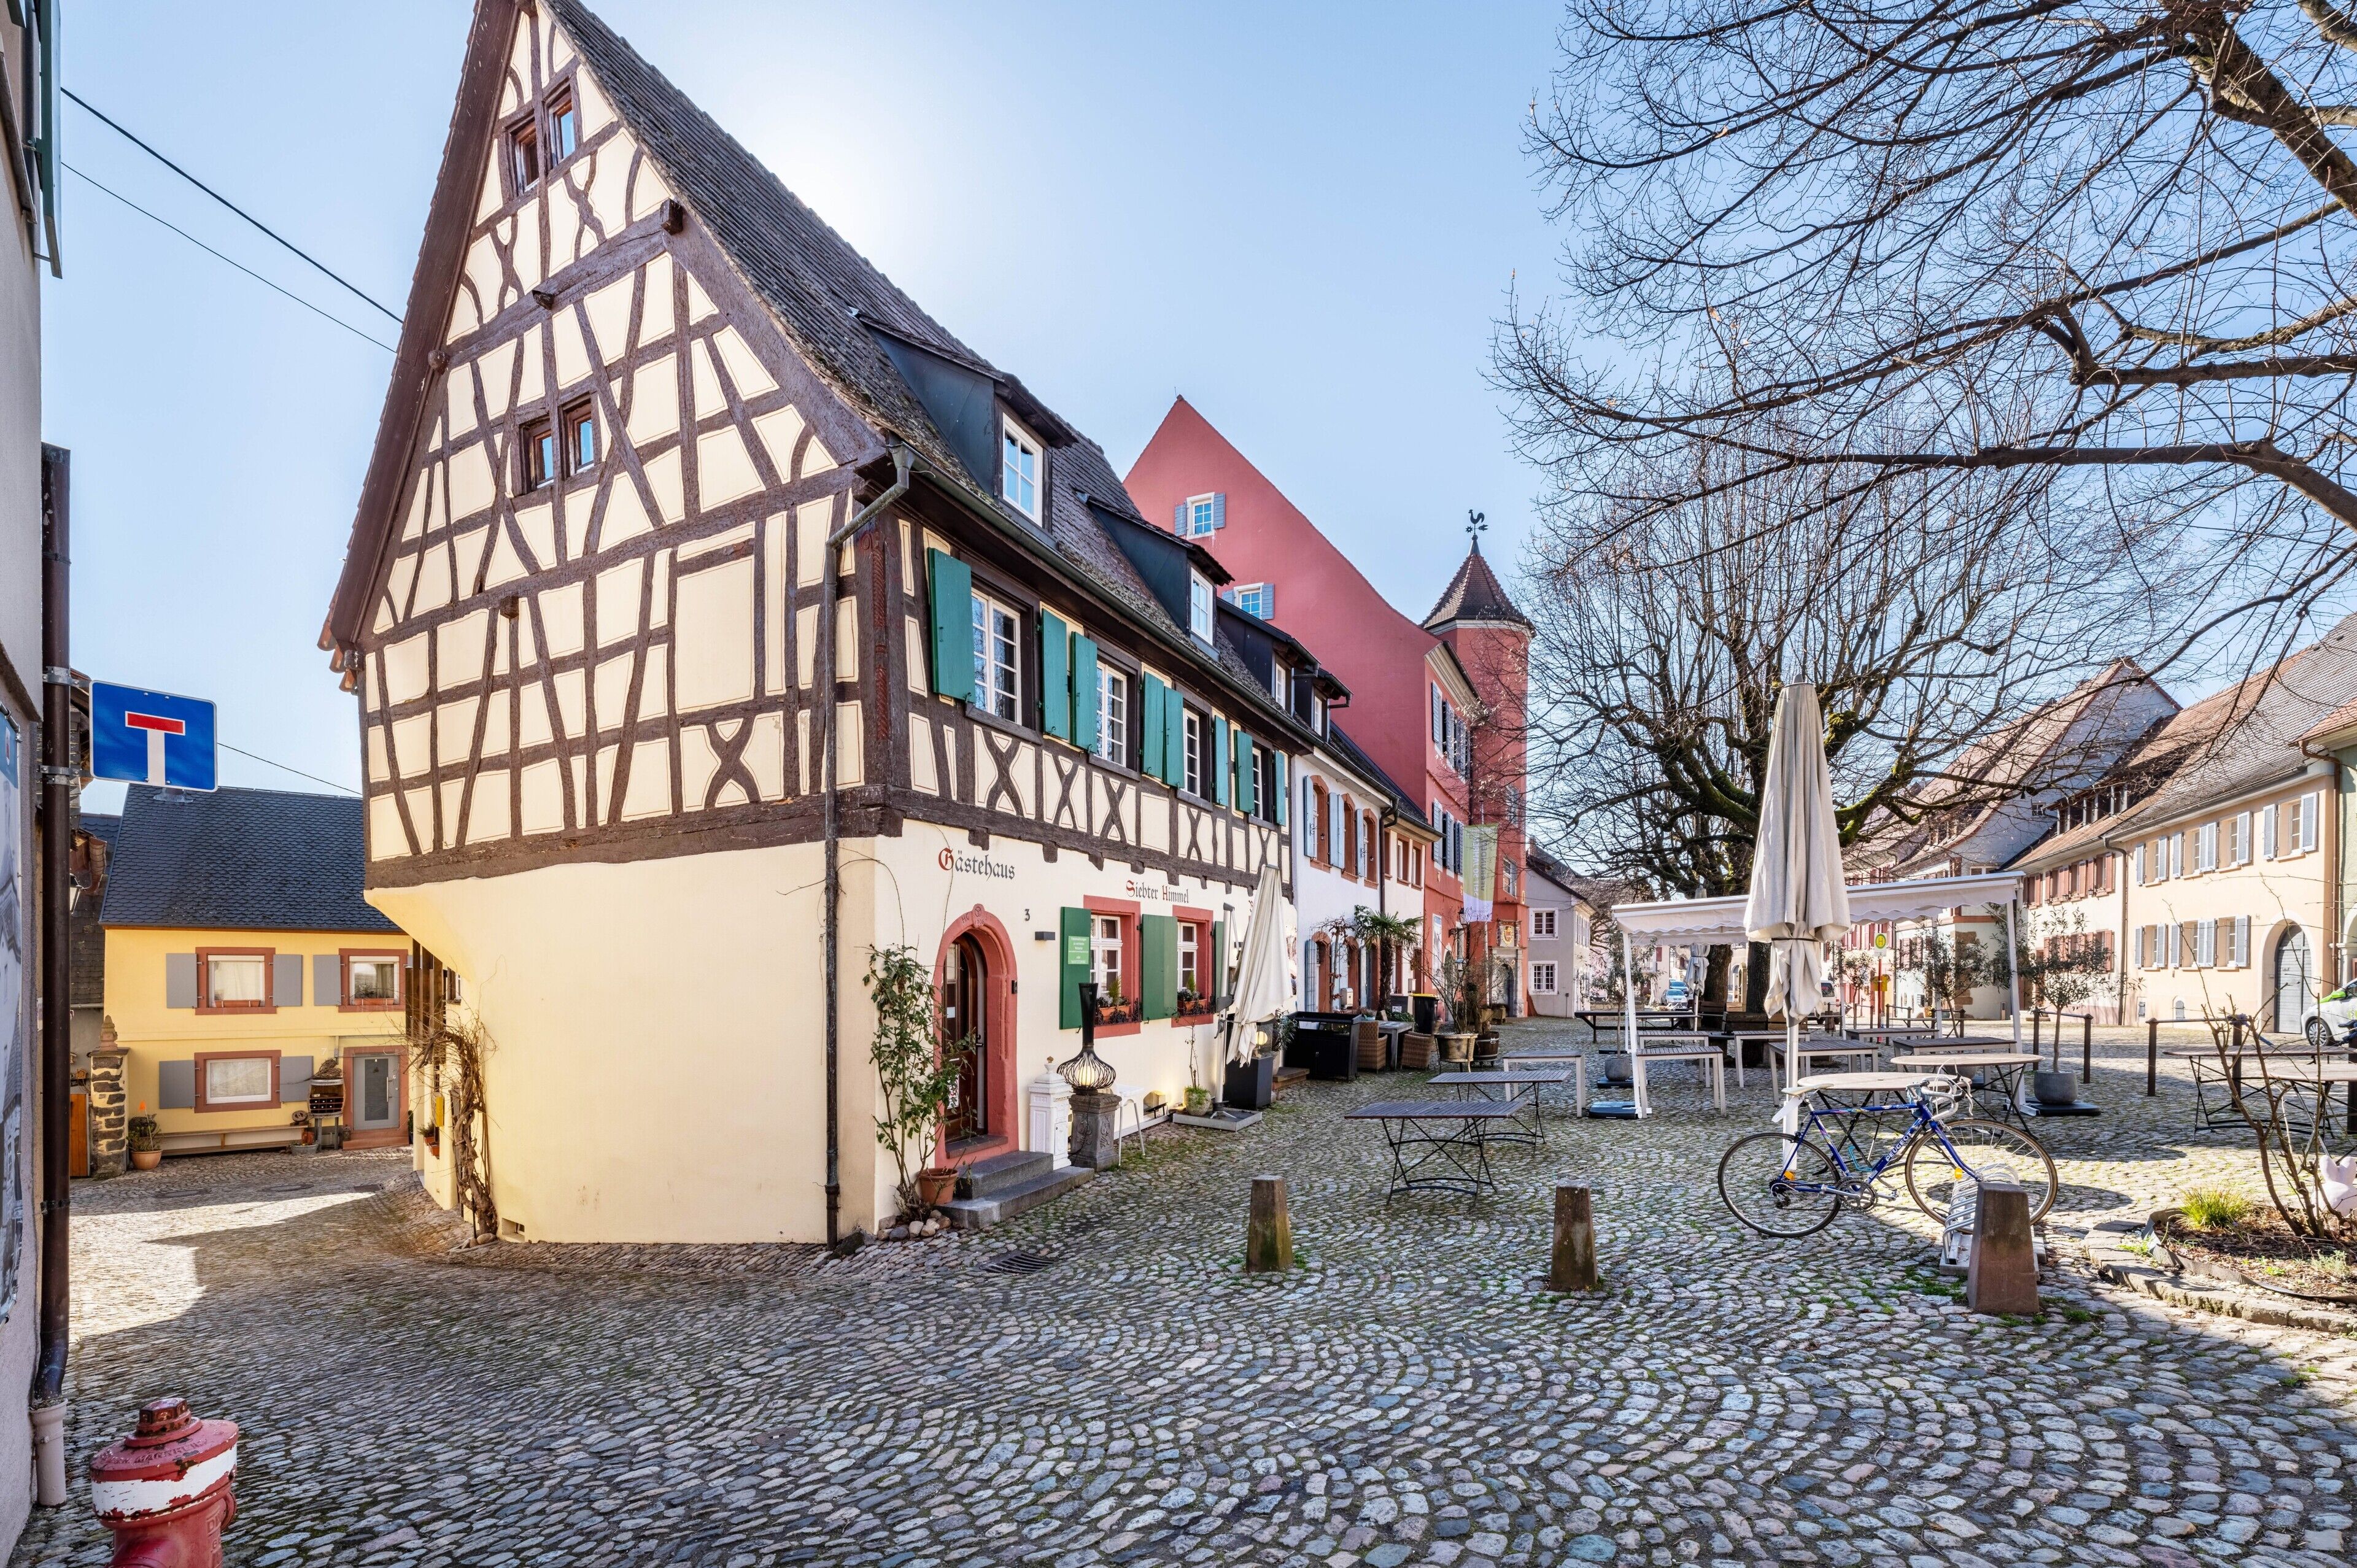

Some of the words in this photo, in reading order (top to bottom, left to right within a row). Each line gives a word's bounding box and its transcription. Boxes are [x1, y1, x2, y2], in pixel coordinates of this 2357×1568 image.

[938, 847, 1015, 881] Gästehaus
[1126, 879, 1158, 900] Siebter
[1161, 884, 1189, 903] Himmel
[1024, 908, 1031, 921] 3
[1885, 1130, 1913, 1162] PEUGEOT
